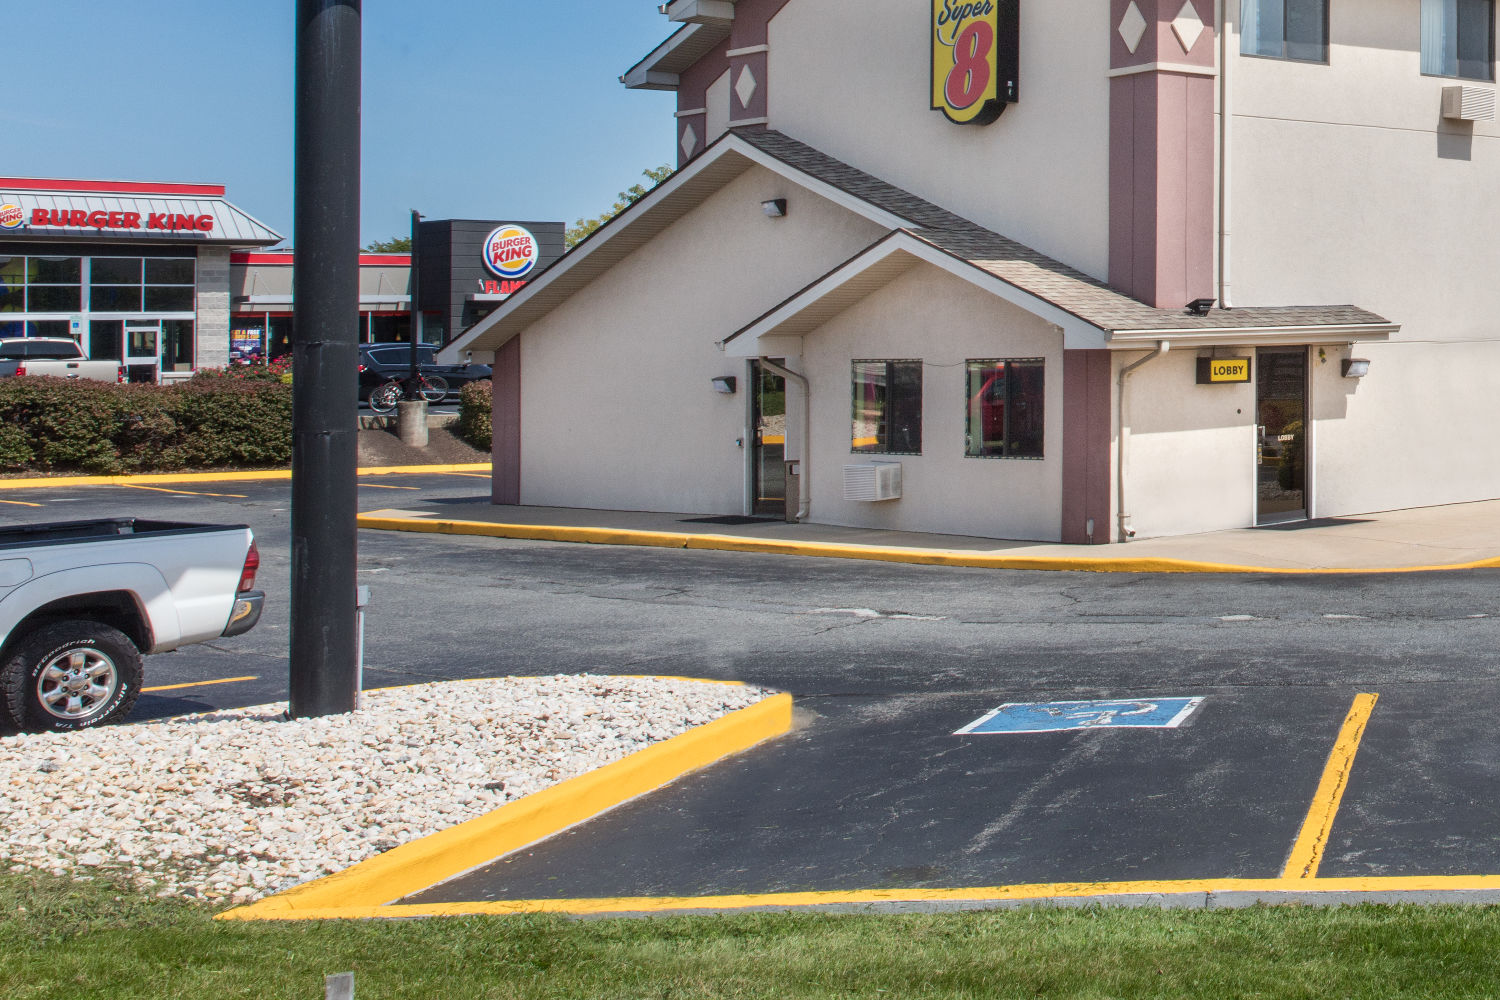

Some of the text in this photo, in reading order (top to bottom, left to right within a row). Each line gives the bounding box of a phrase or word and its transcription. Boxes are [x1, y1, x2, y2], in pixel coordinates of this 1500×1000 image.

[944, 20, 994, 110] 8
[31, 208, 214, 232] BURGER KING
[492, 236, 531, 252] BURGER
[493, 244, 532, 265] KING
[485, 280, 528, 294] FLAM
[1213, 365, 1244, 376] LOBBY
[1277, 434, 1295, 442] LOBBY
[32, 638, 96, 678] BFGoodrich
